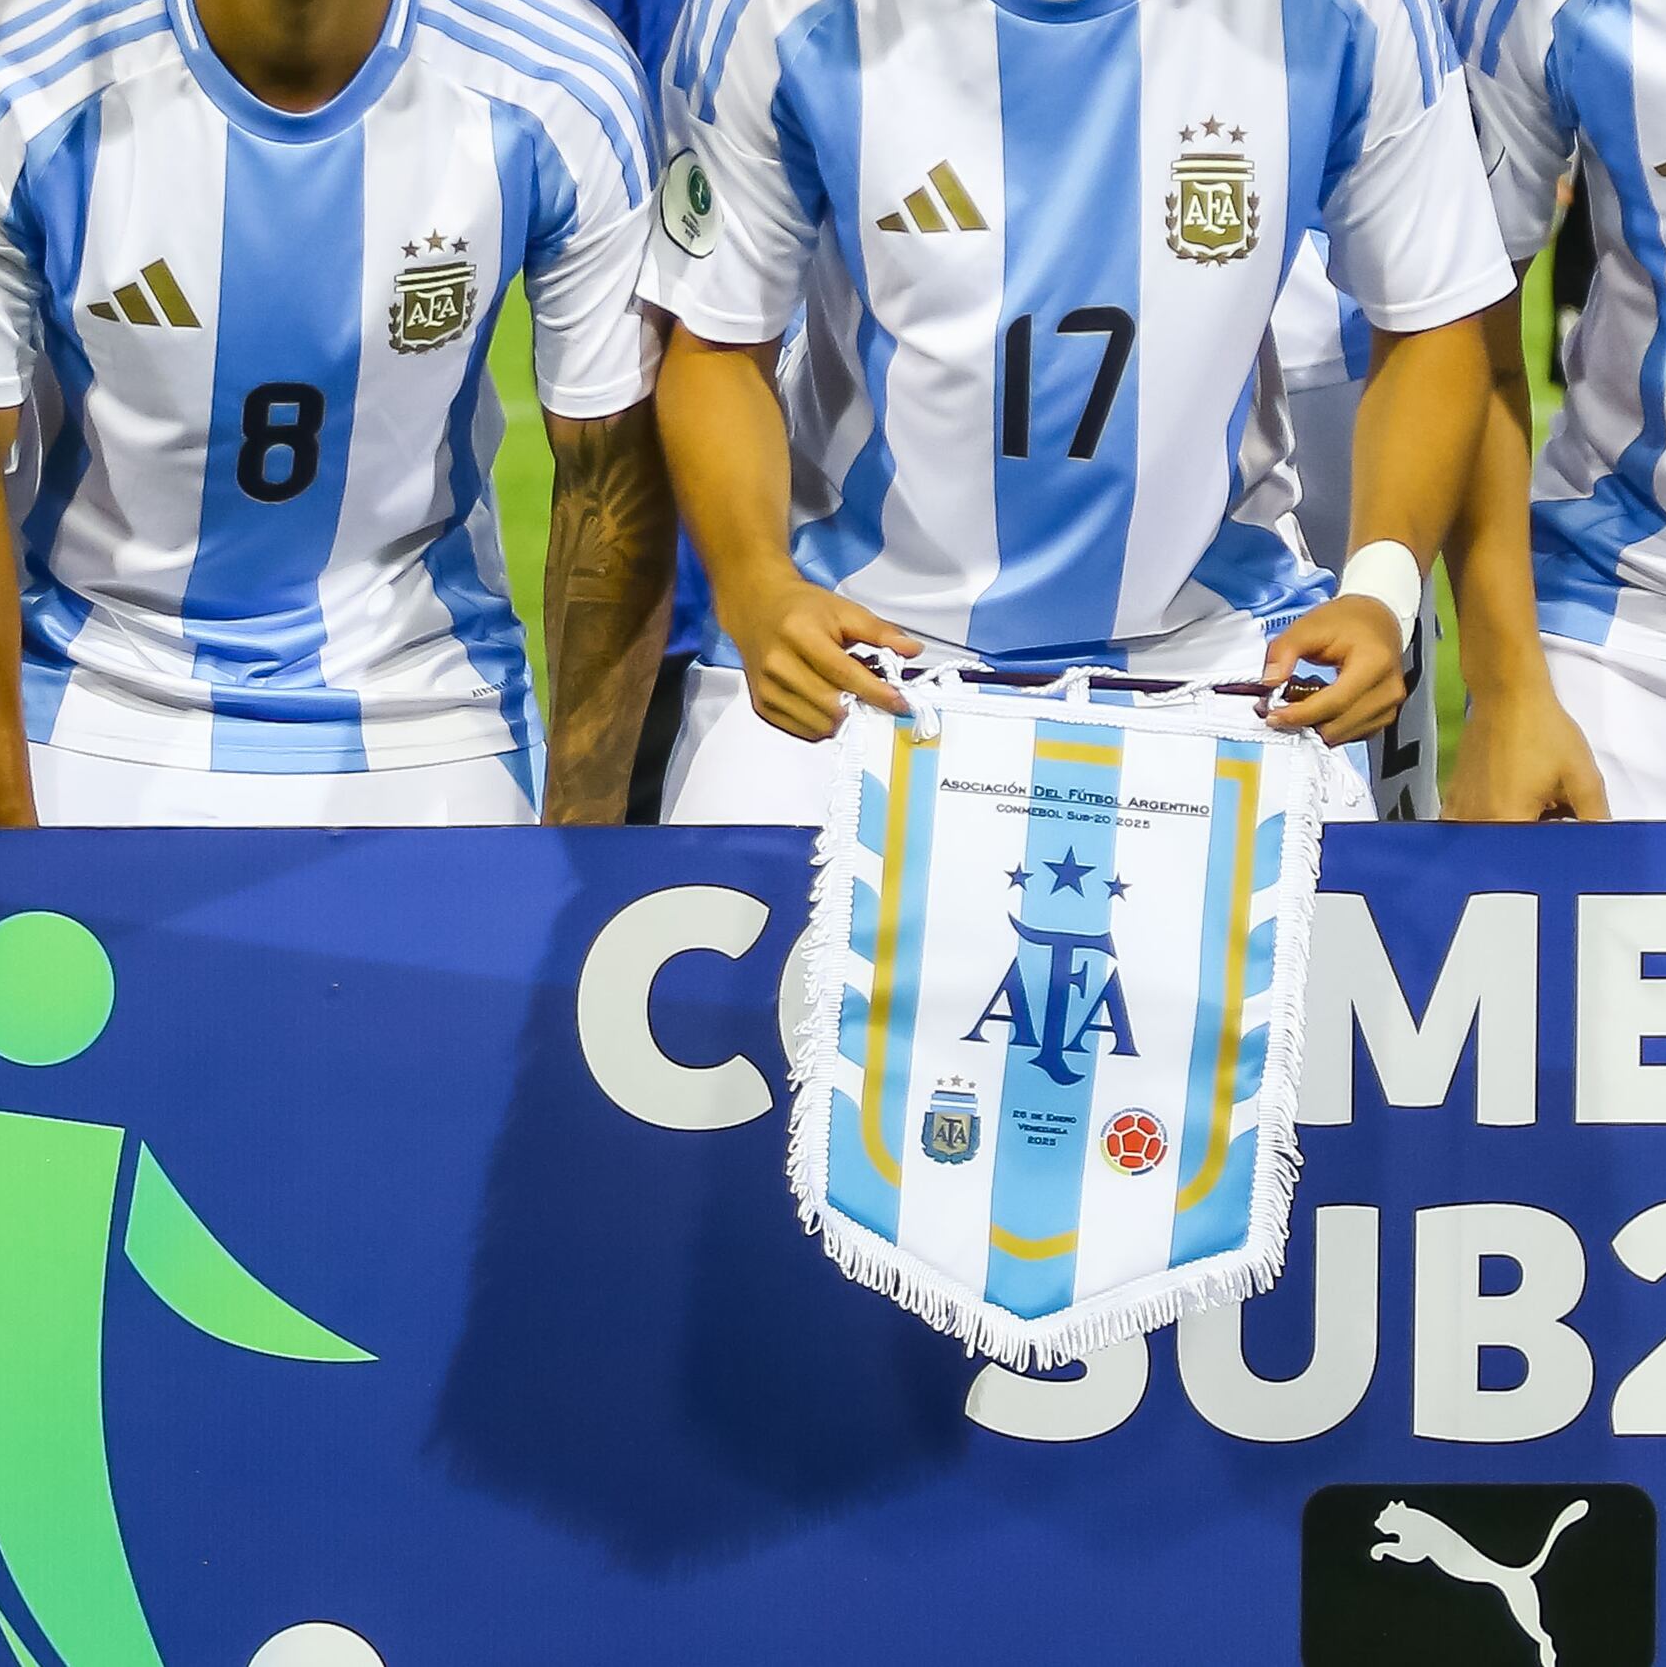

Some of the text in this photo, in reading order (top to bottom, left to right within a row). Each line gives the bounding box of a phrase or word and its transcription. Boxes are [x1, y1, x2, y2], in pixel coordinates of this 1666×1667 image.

[1183, 181, 1241, 235] AFA
[406, 286, 460, 329] AFA
[1001, 305, 1136, 461] 17
[235, 382, 326, 504] 8
[997, 803, 1063, 819] CONMEBOL
[1116, 816, 1151, 829] 2025
[960, 913, 1139, 1085] AFA
[934, 1116, 967, 1148] AFA
